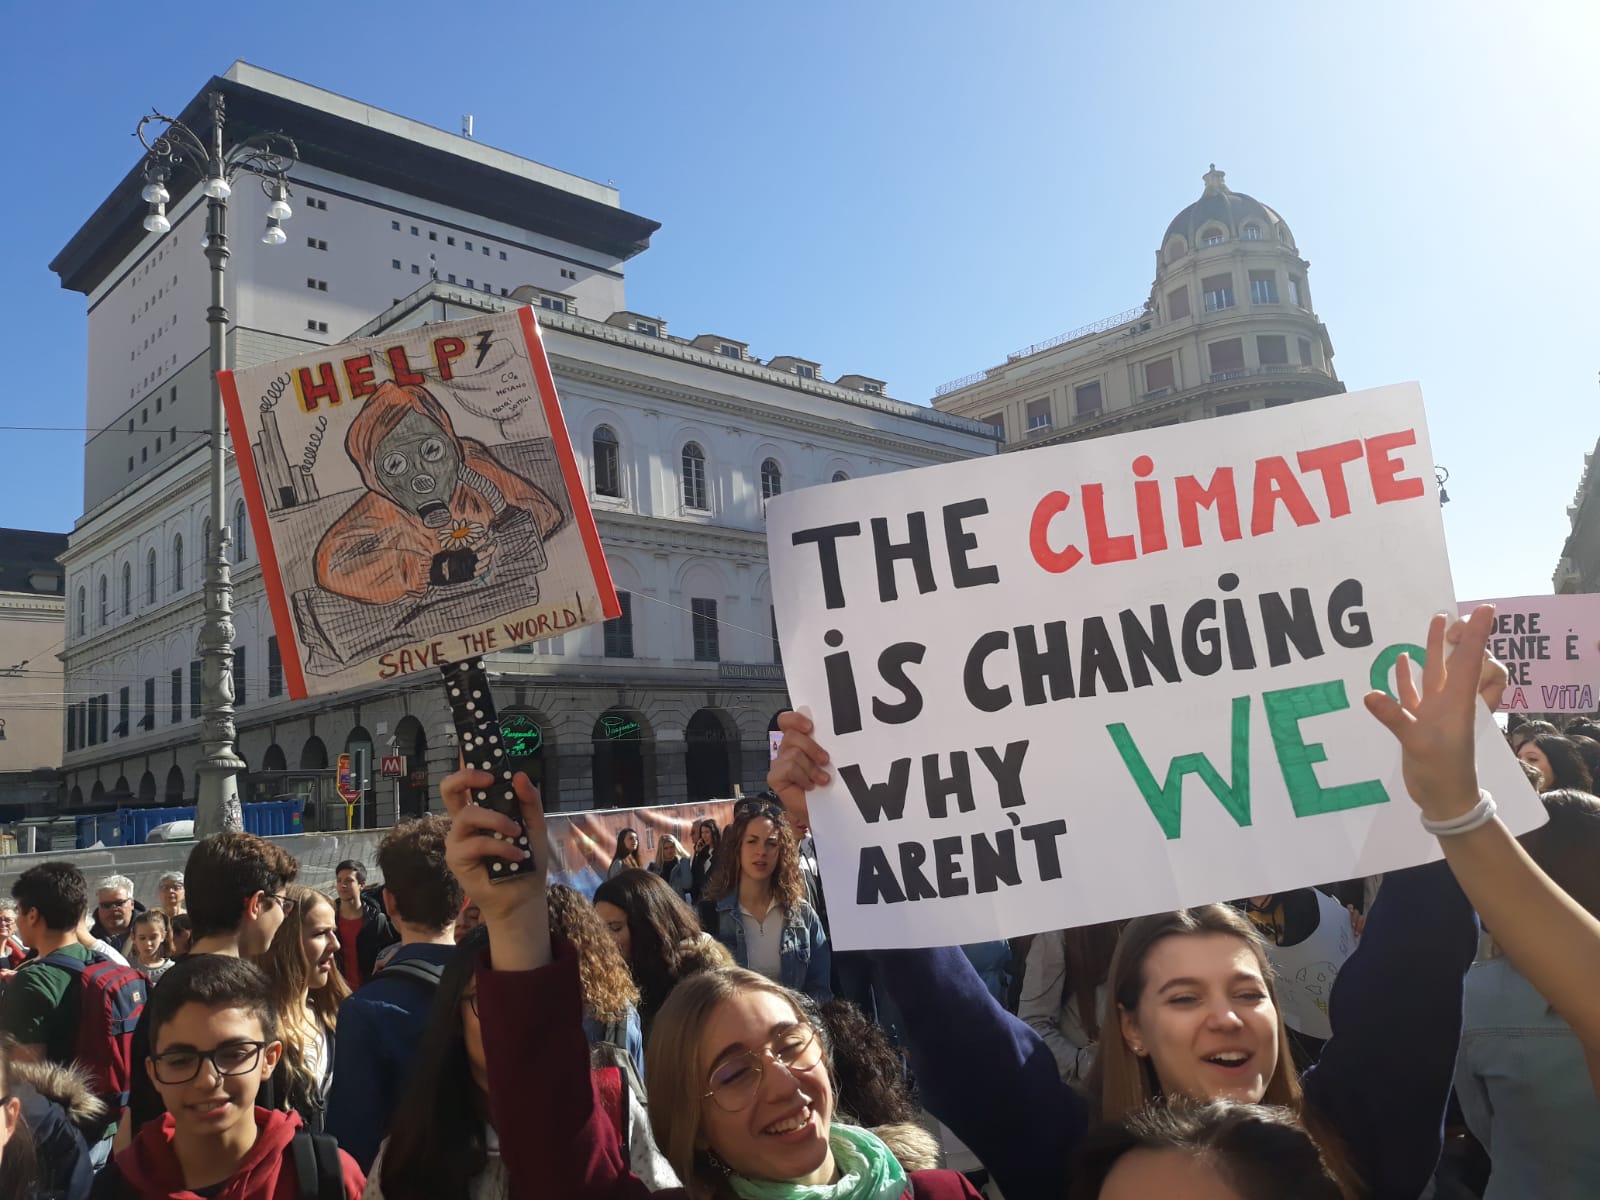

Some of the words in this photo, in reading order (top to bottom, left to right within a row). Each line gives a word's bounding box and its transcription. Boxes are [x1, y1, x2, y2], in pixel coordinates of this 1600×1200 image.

[298, 336, 466, 411] HELP
[792, 498, 999, 609] THE
[379, 641, 449, 679] SAVE
[458, 627, 497, 655] THE
[504, 591, 587, 643] WORLD!
[838, 740, 1029, 823] WHY
[857, 801, 1066, 904] AREN'T
